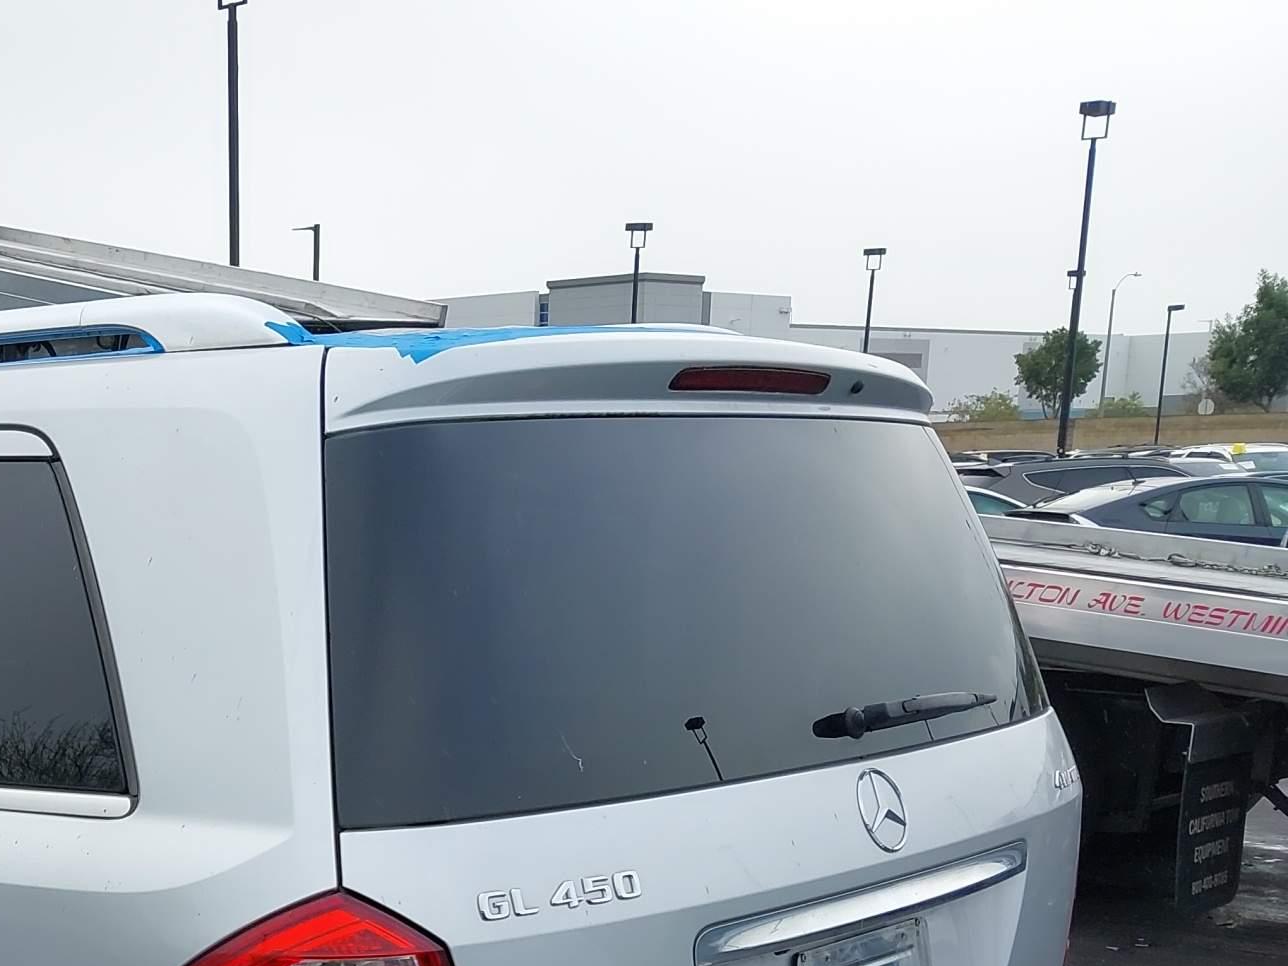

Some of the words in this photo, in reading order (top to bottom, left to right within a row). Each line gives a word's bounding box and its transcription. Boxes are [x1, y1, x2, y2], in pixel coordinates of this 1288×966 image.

[1189, 810, 1225, 835] CALIFORNIA
[1194, 836, 1230, 864] EQUIPMENT
[477, 887, 540, 922] GL
[549, 869, 643, 910] 450
